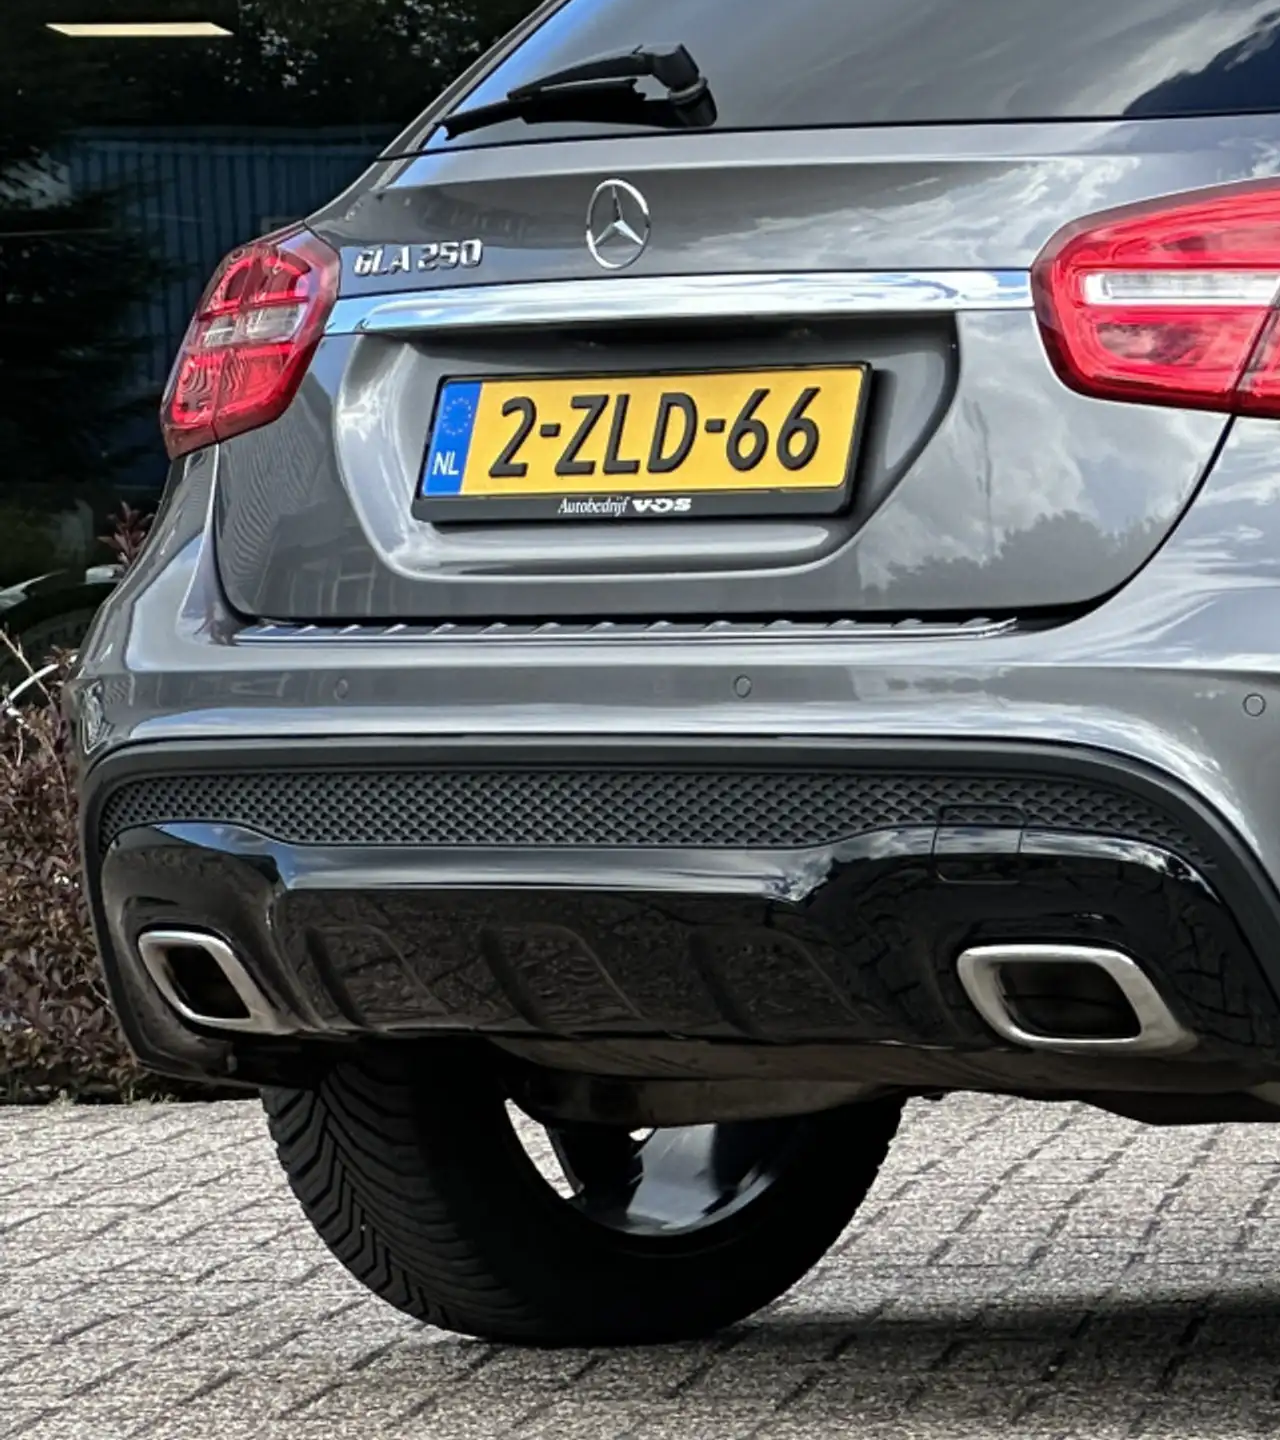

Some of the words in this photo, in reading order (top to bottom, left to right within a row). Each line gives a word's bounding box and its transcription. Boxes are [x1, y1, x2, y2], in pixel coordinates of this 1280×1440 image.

[353, 245, 410, 277] GLA
[417, 239, 483, 271] 250
[488, 386, 822, 478] 2-ZLD-66
[433, 450, 460, 477] NL
[558, 496, 630, 517] Autobedrijf
[632, 497, 692, 513] VOS
